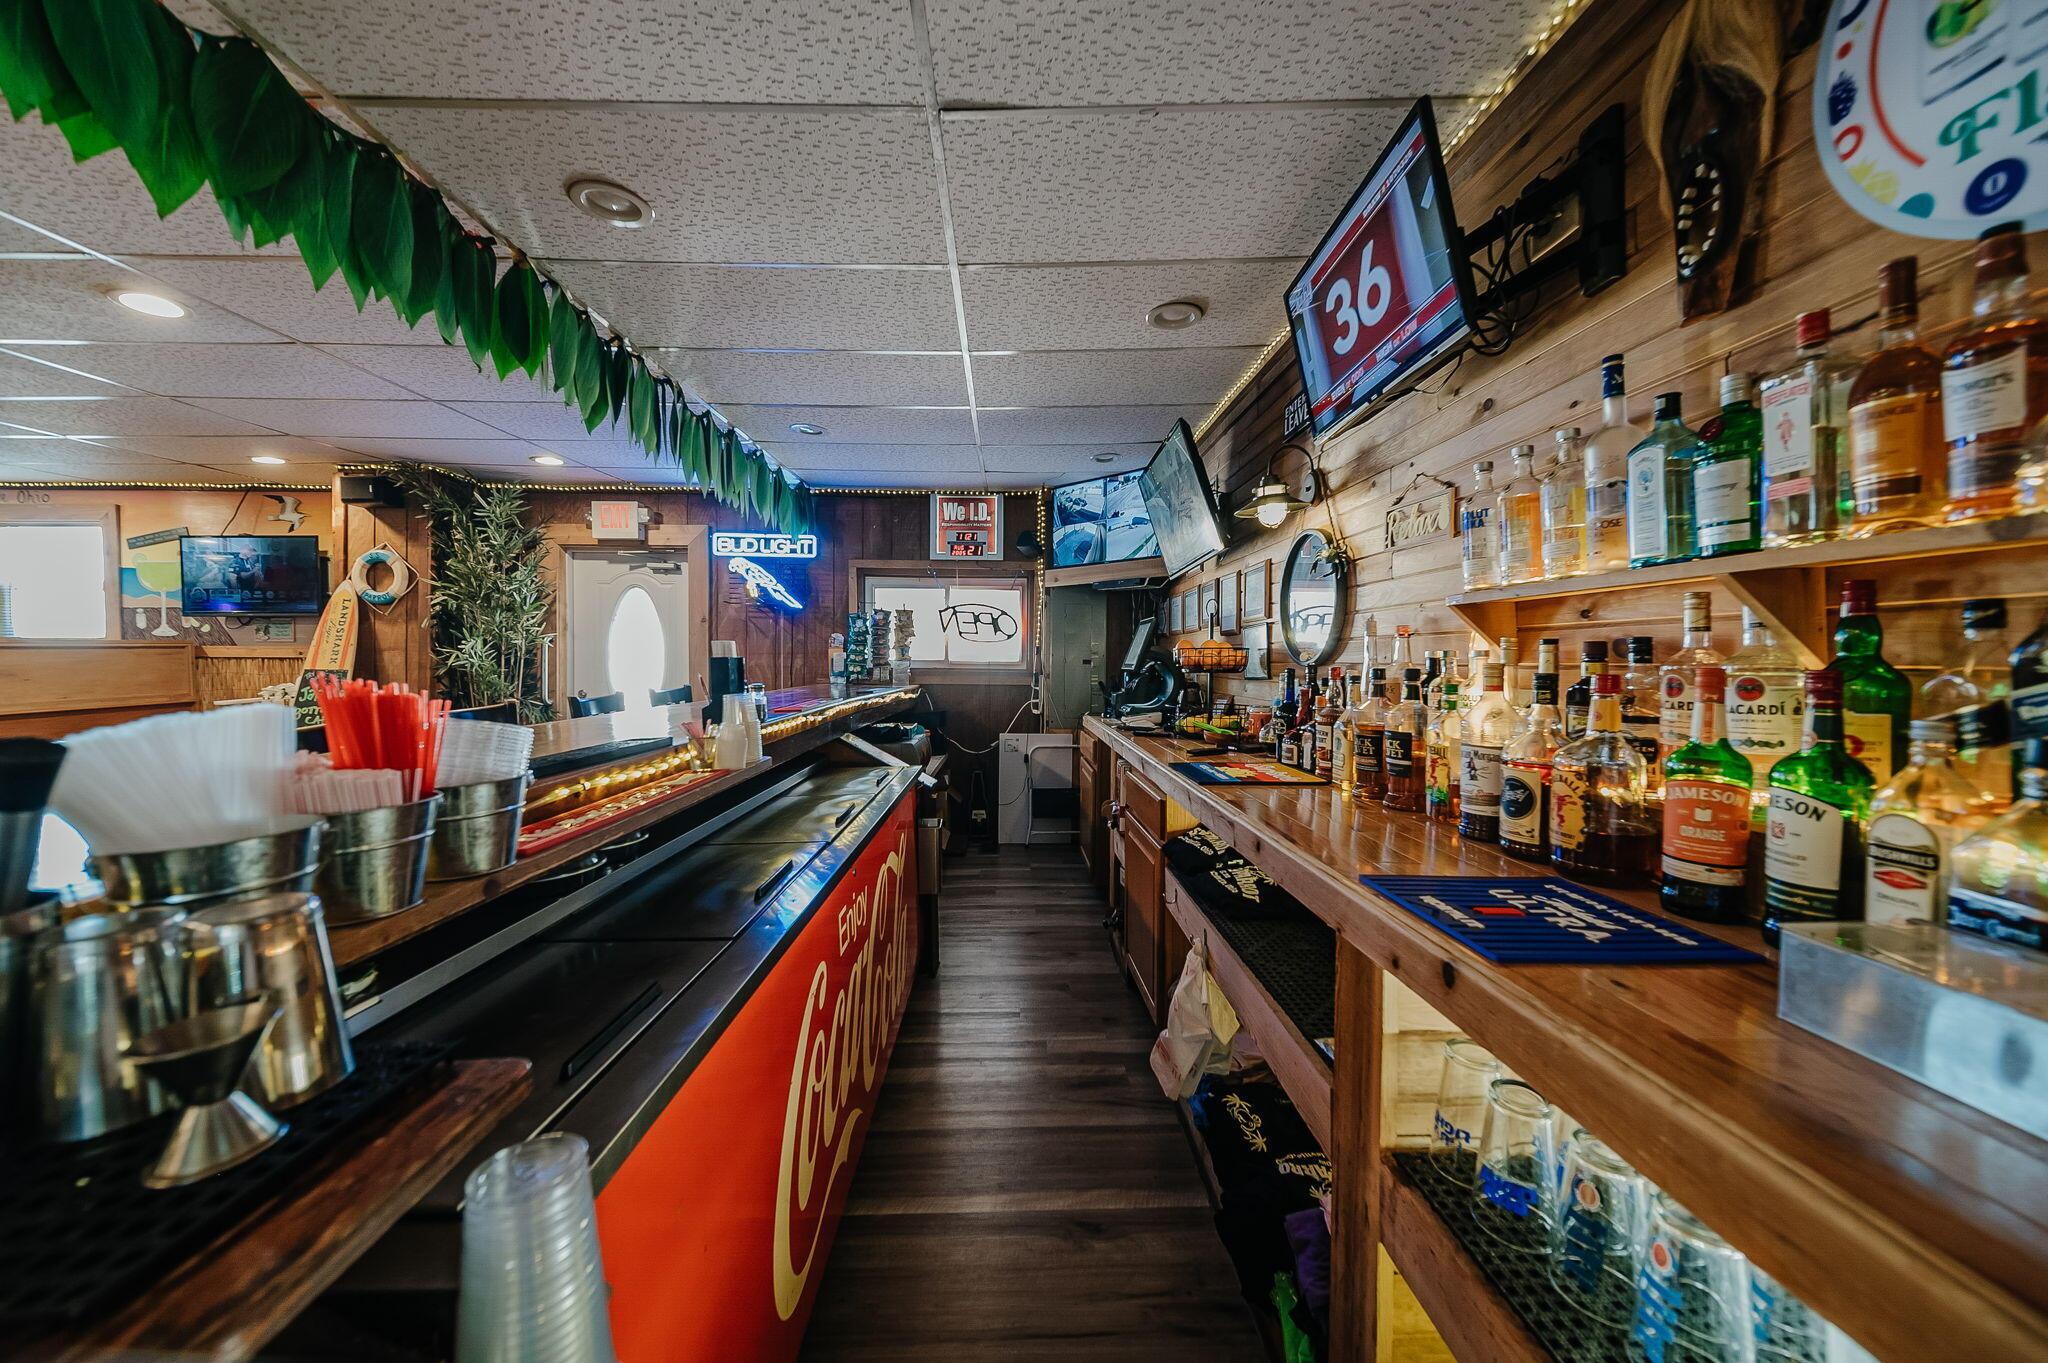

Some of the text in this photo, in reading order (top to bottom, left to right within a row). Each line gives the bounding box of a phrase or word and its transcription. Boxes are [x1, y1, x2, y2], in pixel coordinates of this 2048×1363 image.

[1325, 240, 1391, 355] 36
[600, 503, 630, 529] EXIT
[942, 502, 991, 521] We I.D.
[717, 538, 814, 555] BUD LIGHT
[328, 597, 352, 665] LANDSHARK
[1667, 786, 1746, 808] JAMESON
[837, 883, 869, 957] Enjoy
[1488, 889, 1612, 944] ULTRA
[772, 832, 908, 1321] Coca-Cola
